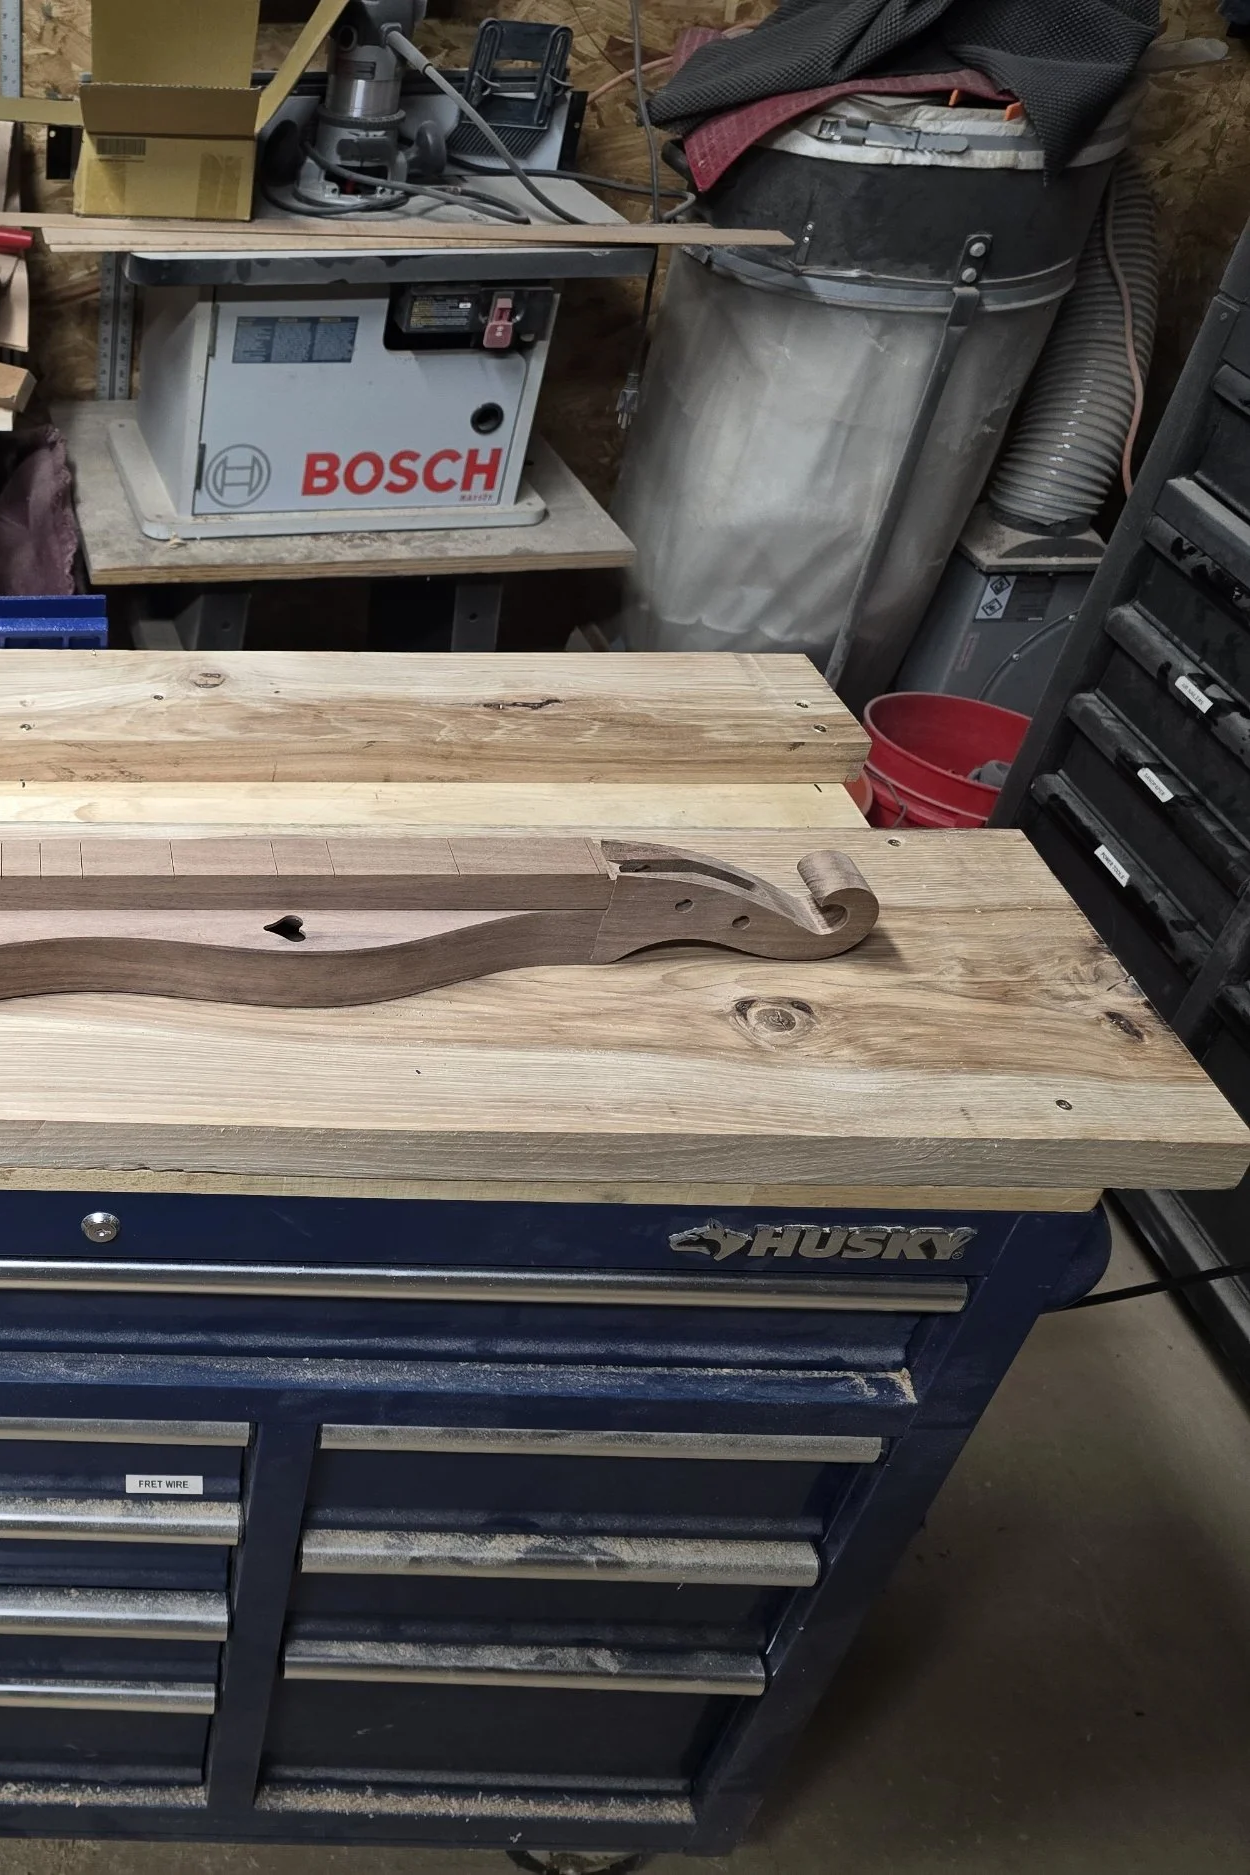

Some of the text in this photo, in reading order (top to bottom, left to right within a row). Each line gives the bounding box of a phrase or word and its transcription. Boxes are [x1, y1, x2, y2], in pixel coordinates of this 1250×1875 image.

[301, 448, 503, 496] BOSCH
[1144, 772, 1165, 796] SANDPAPER
[1101, 852, 1114, 867] POWER
[748, 1223, 978, 1260] HUSKY
[138, 1480, 189, 1489] FRET WIRE
